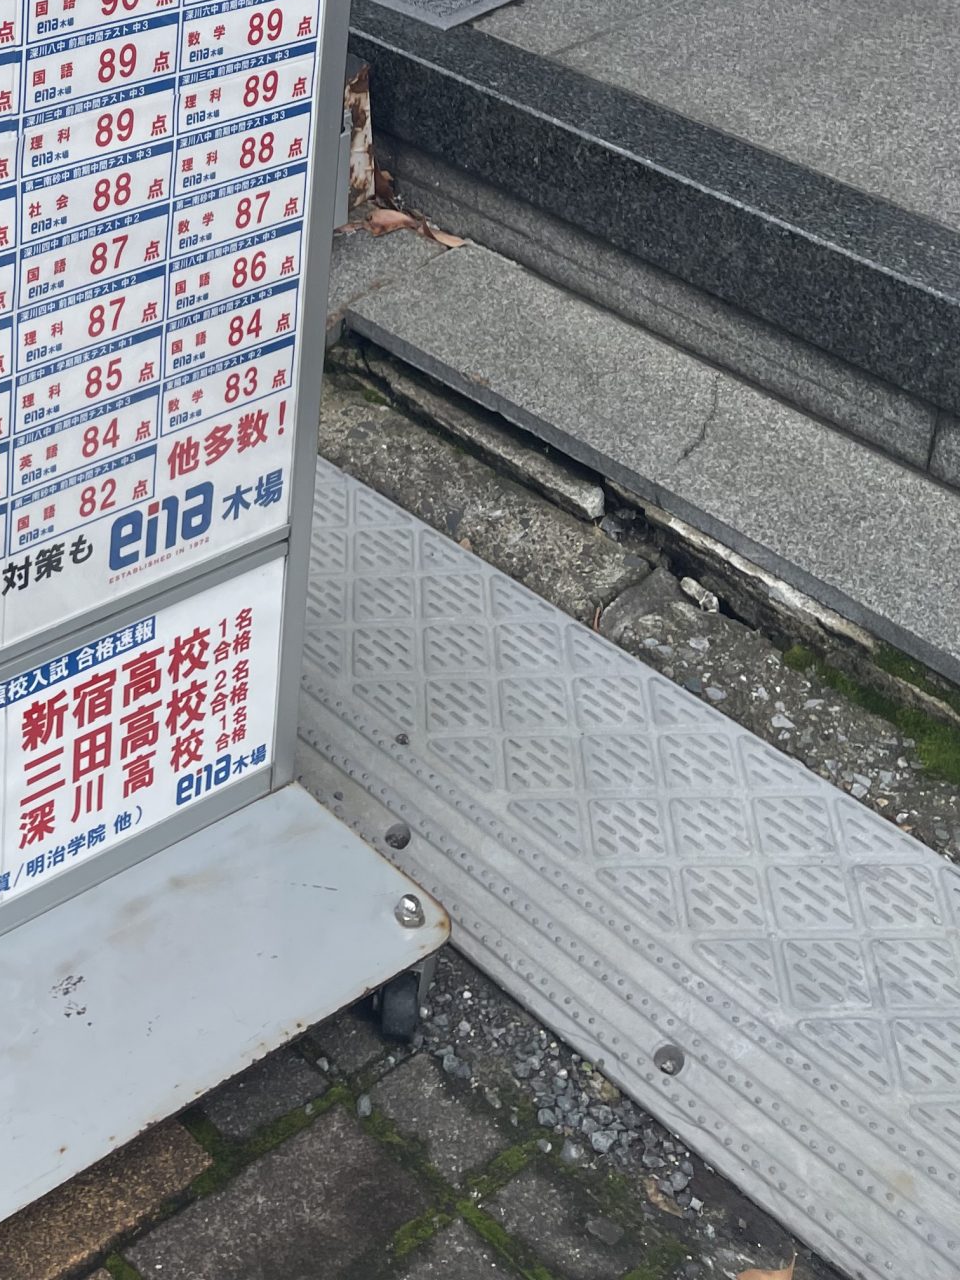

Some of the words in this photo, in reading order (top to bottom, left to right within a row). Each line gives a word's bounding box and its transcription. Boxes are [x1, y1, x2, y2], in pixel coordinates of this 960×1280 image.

[120, 453, 136, 467] 中3
[167, 400, 287, 480] 他多数！
[109, 481, 214, 571] ena
[221, 468, 283, 520] 木場
[109, 553, 171, 584] ESTABLISHED
[176, 547, 185, 556] IN
[190, 536, 209, 549] 1972
[76, 619, 153, 670] 合格速報
[213, 630, 252, 665] 合格
[21, 626, 210, 752] 新宿高校
[210, 681, 248, 715] 合格
[20, 679, 208, 807] 三田高校
[215, 724, 247, 752] 合格
[18, 728, 204, 850] 深川高校
[176, 754, 231, 806] ena
[232, 743, 266, 775] 木場
